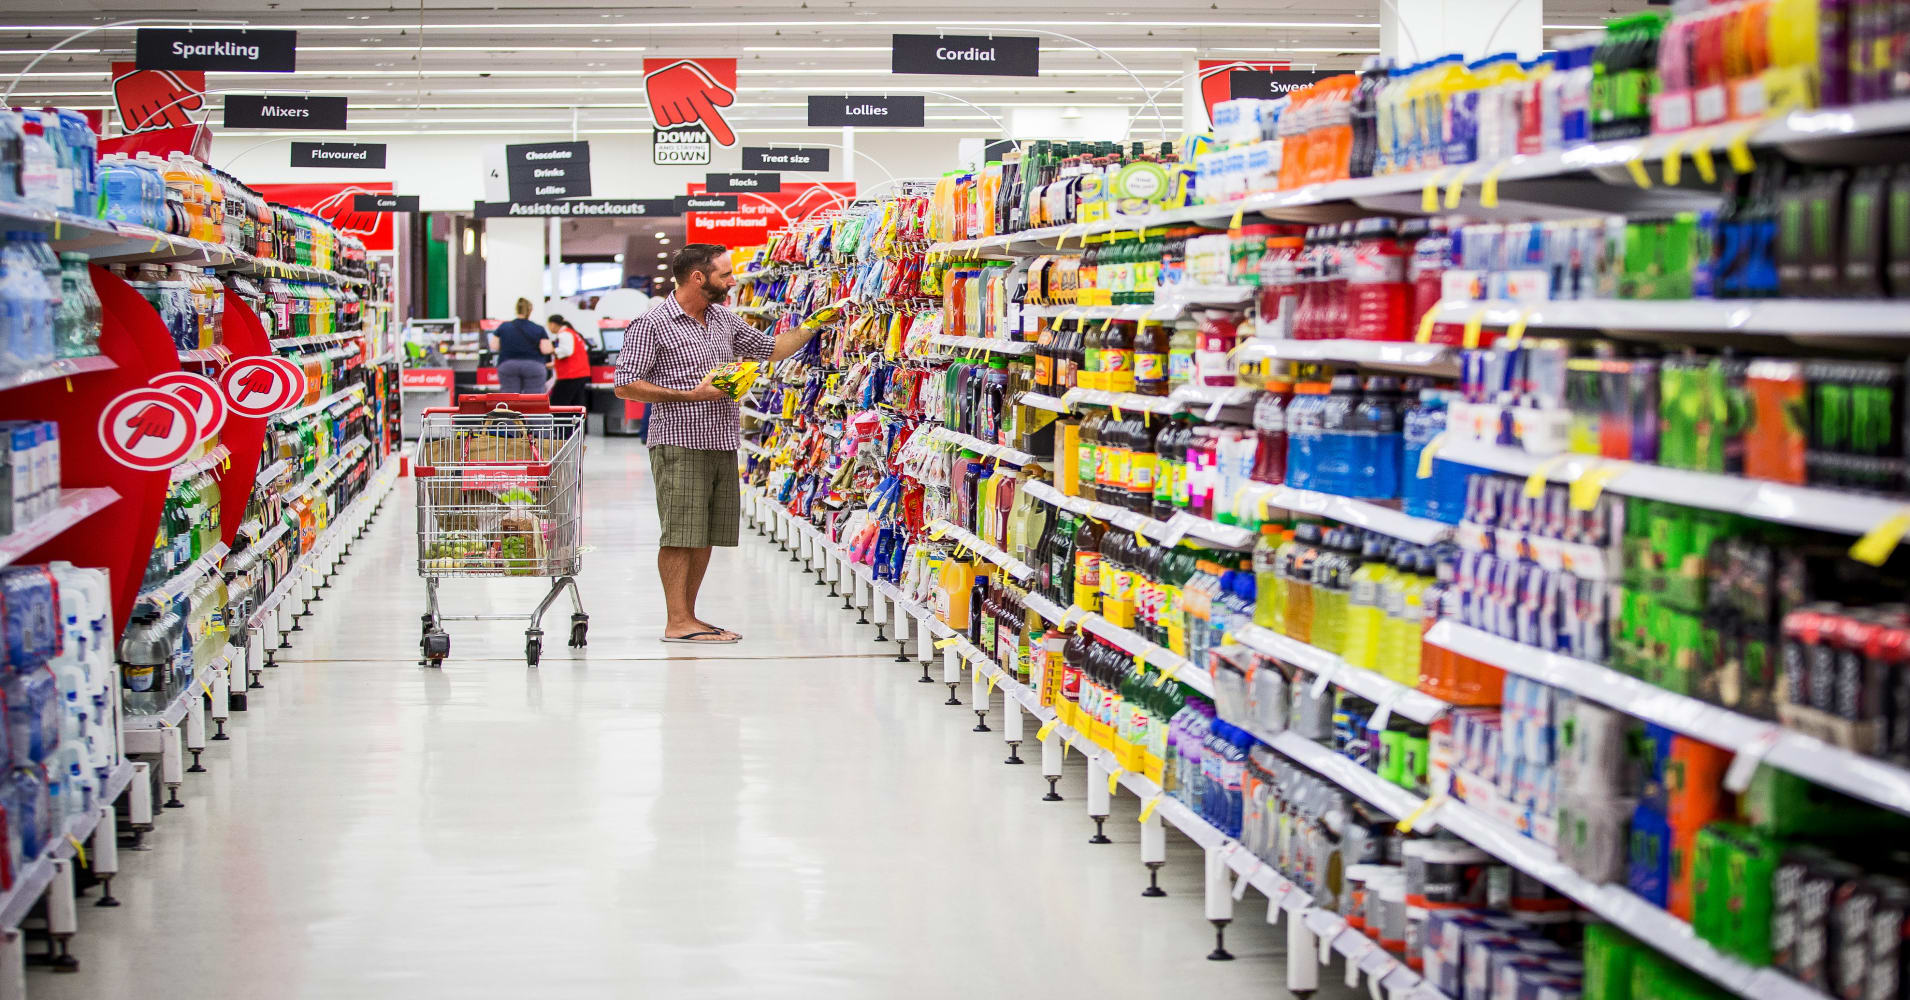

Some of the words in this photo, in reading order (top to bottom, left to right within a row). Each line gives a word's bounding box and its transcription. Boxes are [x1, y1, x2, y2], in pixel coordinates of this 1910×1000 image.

[172, 41, 260, 60] Sparkling
[935, 46, 996, 62] Cordial
[261, 105, 310, 118] Mixers
[845, 104, 889, 117] Lollies
[656, 131, 708, 143] DOWN
[311, 149, 367, 160] Flavoured
[525, 150, 573, 161] Chocolate
[658, 151, 706, 161] DOWN
[761, 153, 788, 164] Treat
[789, 153, 810, 164] size
[490, 168, 499, 179] 4
[533, 167, 566, 178] Drinks
[729, 178, 759, 187] Blocks
[535, 185, 567, 196] Lollies
[509, 202, 570, 215] Assisted
[571, 202, 646, 215] checkouts
[687, 199, 726, 208] Chocolate
[741, 204, 757, 214] for
[758, 204, 775, 214] the
[695, 216, 715, 230] big
[715, 216, 736, 228] red
[736, 216, 768, 228] hand
